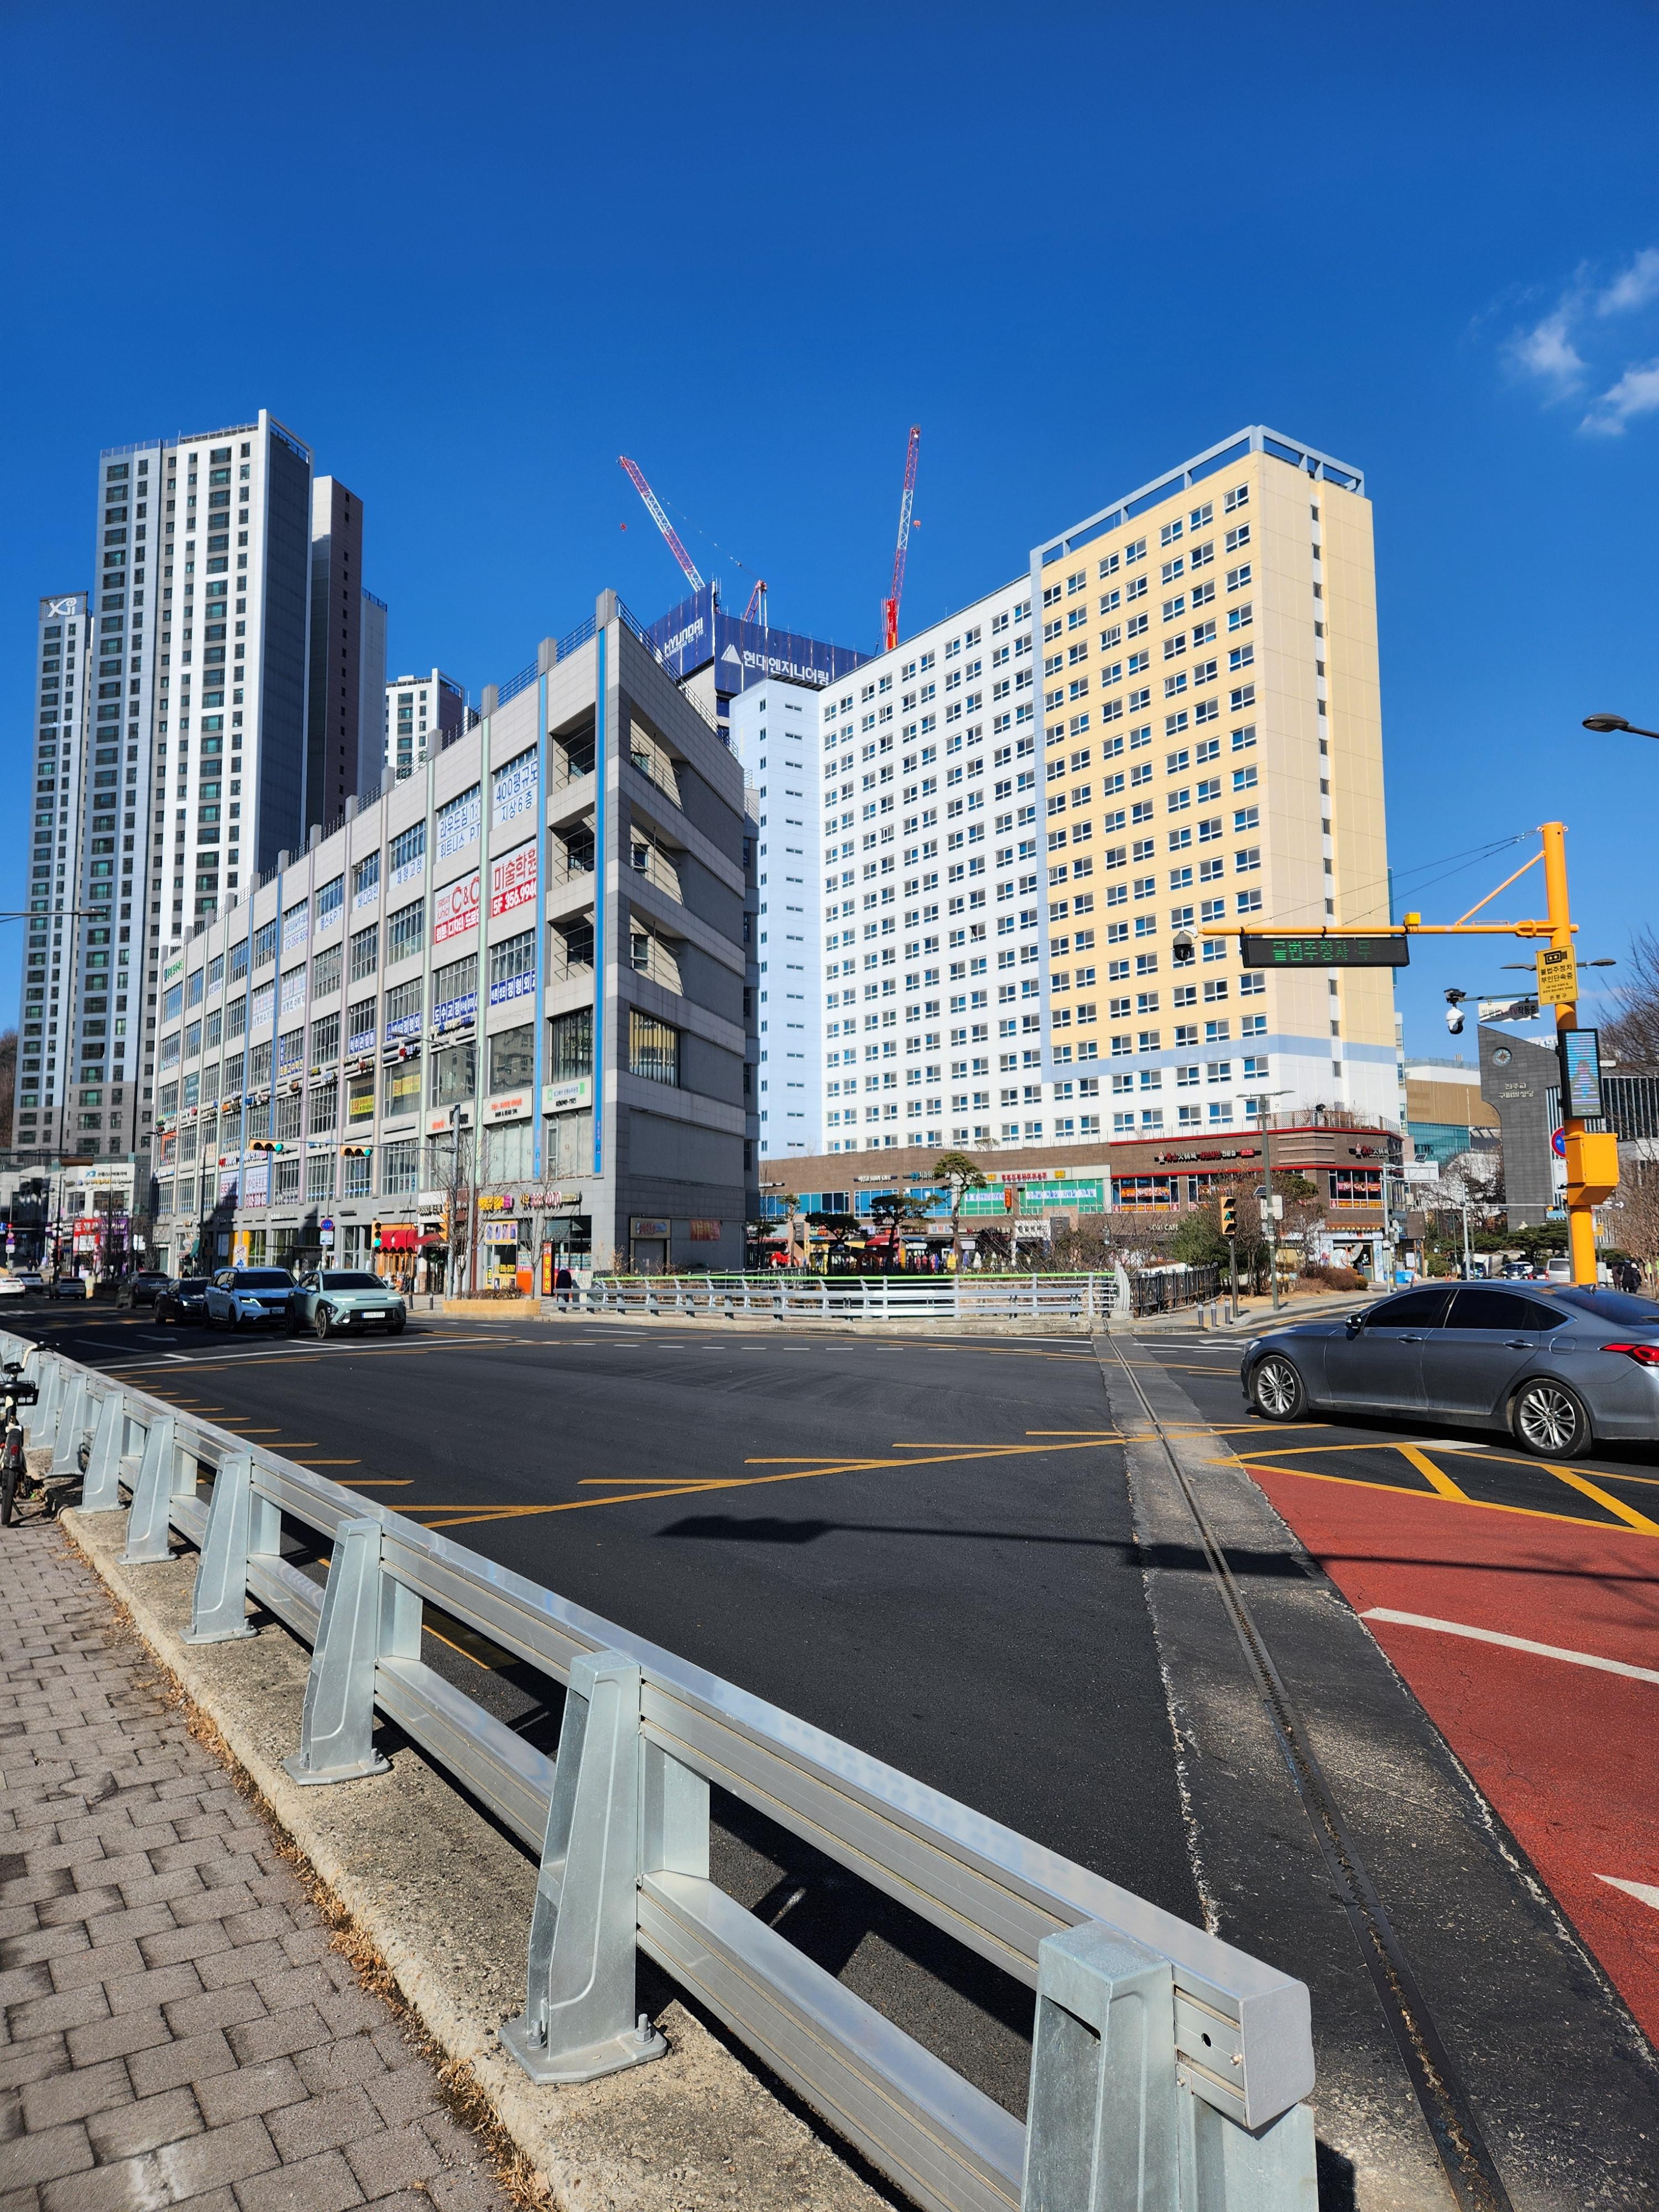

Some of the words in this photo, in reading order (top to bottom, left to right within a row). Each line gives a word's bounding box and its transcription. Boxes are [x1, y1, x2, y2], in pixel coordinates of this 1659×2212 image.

[664, 617, 703, 655] HYUNDAI
[743, 650, 829, 686] 현대엔지니어링
[397, 857, 421, 884] 체형교정
[494, 848, 536, 891] 미술학원
[358, 883, 379, 909] 바디라인
[493, 896, 503, 915] 5F
[1541, 972, 1573, 984] 무인단속중
[1498, 1091, 1534, 1099] 구파발성당
